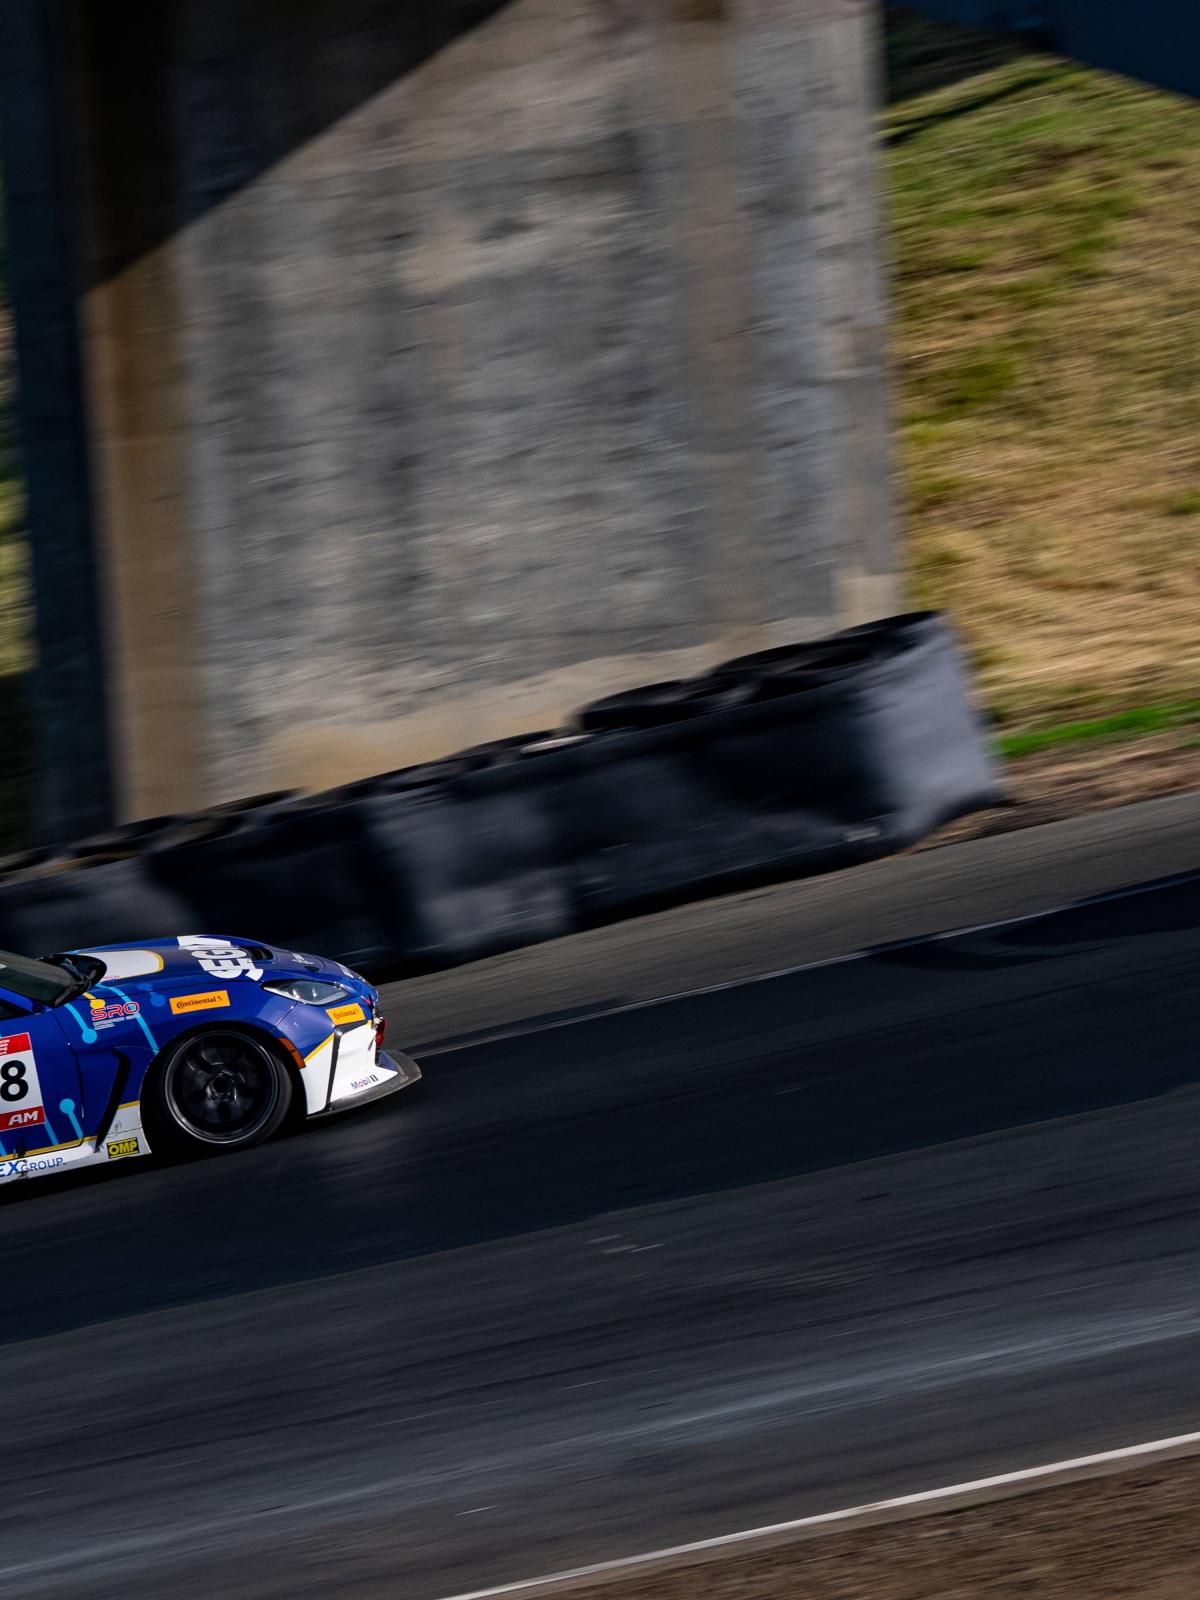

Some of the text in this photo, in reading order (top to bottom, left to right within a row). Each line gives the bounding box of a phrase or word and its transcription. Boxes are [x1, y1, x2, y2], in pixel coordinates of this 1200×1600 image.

[176, 996, 216, 1009] Continental
[90, 1002, 140, 1021] SRO
[350, 1075, 372, 1089] Mobil
[8, 1110, 39, 1126] AM
[108, 1140, 138, 1155] OMP
